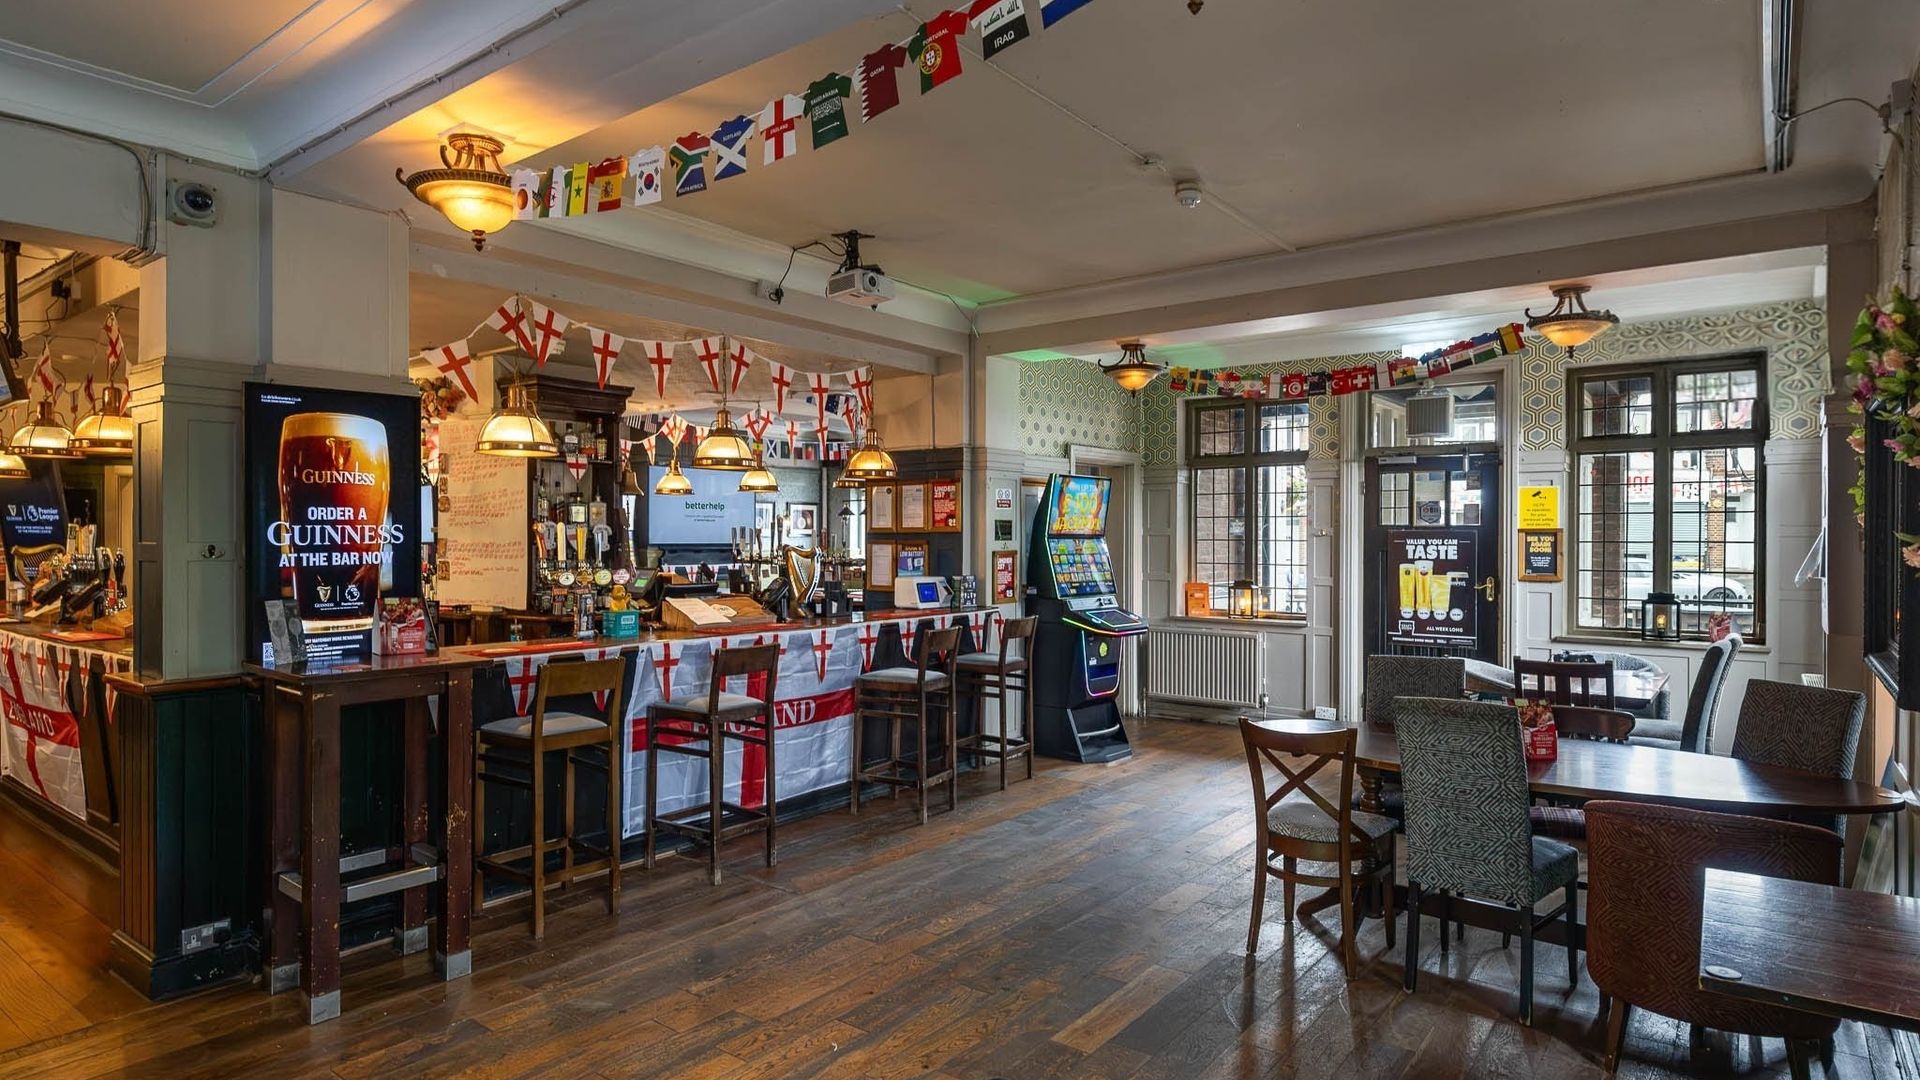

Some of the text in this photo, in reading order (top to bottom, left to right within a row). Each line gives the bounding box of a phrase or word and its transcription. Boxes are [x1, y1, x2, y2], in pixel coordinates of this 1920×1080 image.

[922, 27, 950, 46] PORTUGAL
[993, 30, 1016, 49] IRAQ
[869, 65, 885, 78] QATAR
[810, 88, 838, 105] SAUDI ARABIA
[771, 123, 789, 134] ENGLAND
[723, 130, 742, 142] SCOTLAND
[690, 183, 704, 191] AFRICA
[302, 468, 376, 486] GUINNESS
[933, 485, 957, 494] UNDER
[38, 507, 58, 515] Premier
[307, 506, 367, 521] ORDER A
[684, 501, 726, 512] betterhelp
[40, 512, 59, 521] League
[267, 520, 404, 546] GUINNESS
[279, 551, 394, 567] AT THE BAR NOW
[1406, 545, 1458, 560] TASTE
